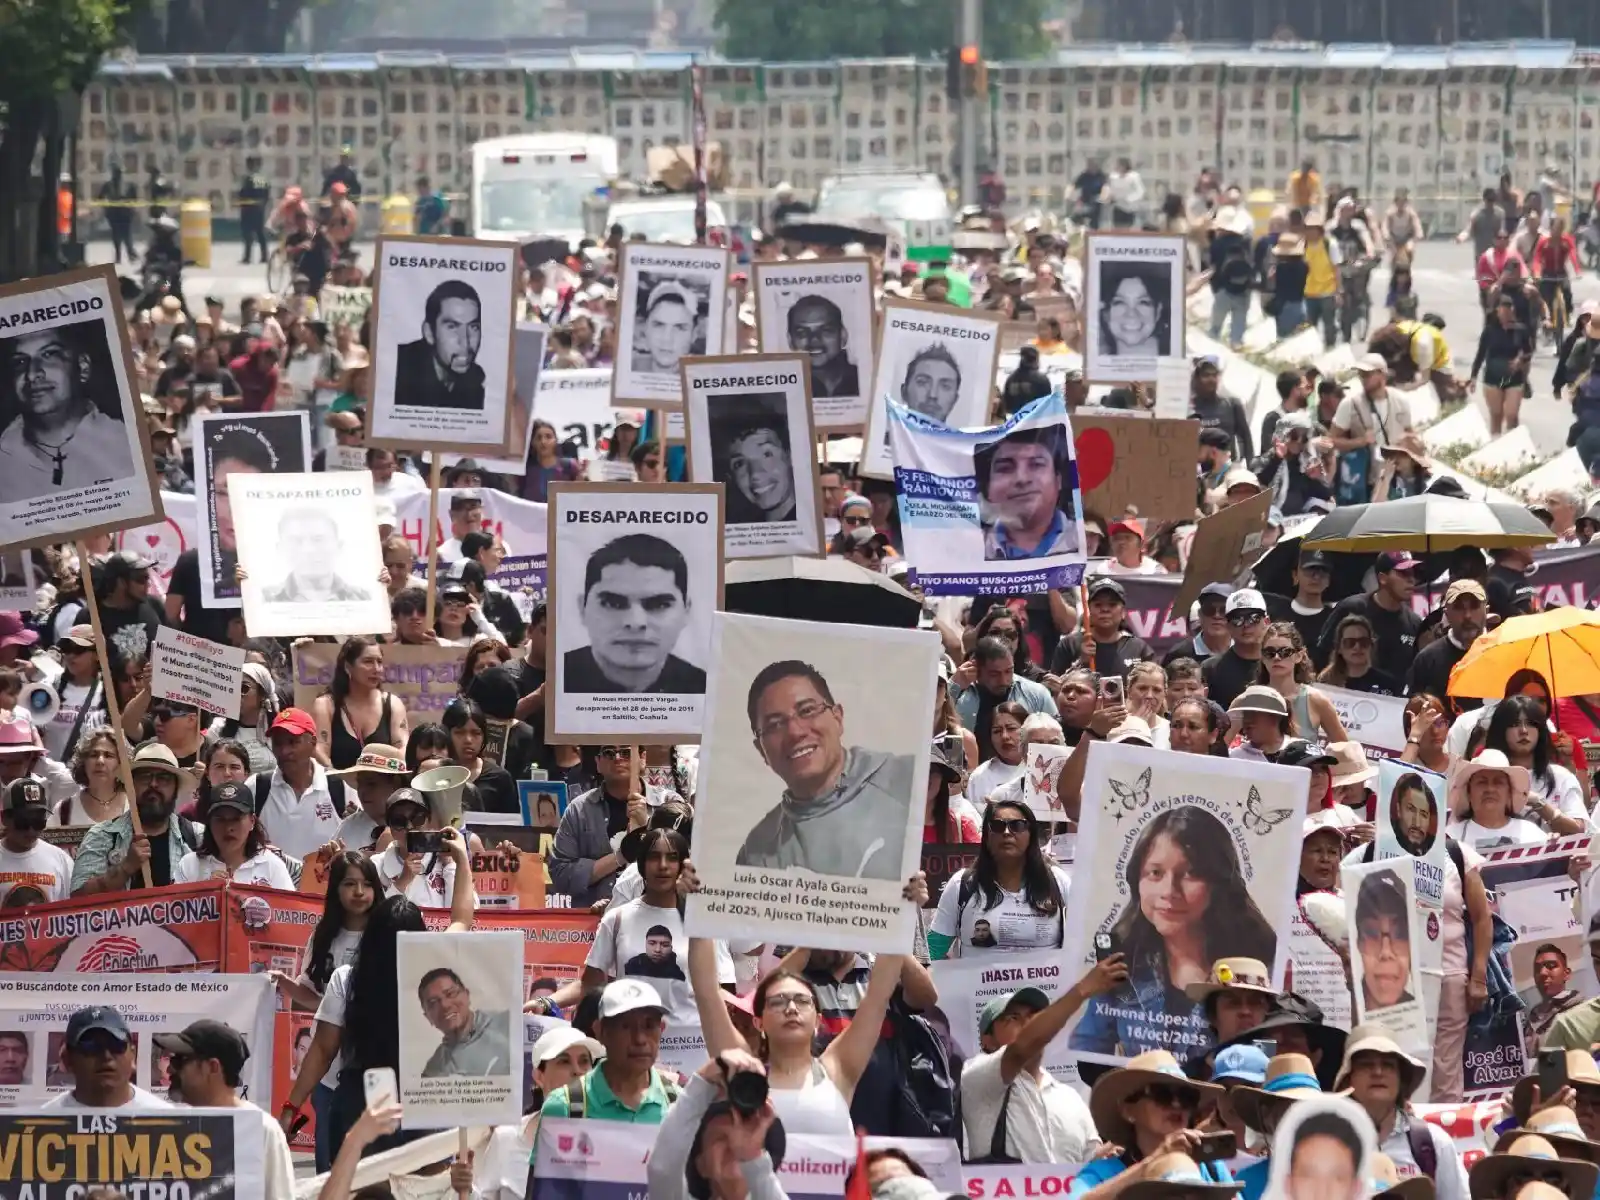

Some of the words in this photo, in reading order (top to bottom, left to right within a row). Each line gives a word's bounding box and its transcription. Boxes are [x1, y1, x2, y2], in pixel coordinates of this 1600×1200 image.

[389, 256, 507, 273] DESAPARECIDO
[630, 256, 722, 270] DESAPARECIDO
[765, 274, 863, 287] DESAPARECIDO
[0, 296, 104, 330] APARECIDO
[891, 319, 991, 341] DESAPARECIDO
[693, 374, 798, 389] DESAPARECIDO
[912, 472, 977, 489] FERNANDO
[566, 510, 709, 525] DESAPARECIDO
[918, 577, 941, 585] TIVO
[943, 577, 979, 585] MANOS
[981, 573, 1047, 585] BUSCADORAS
[978, 586, 991, 595] 33
[1035, 583, 1048, 592] 70
[575, 705, 621, 713] desaparecido
[650, 706, 667, 714] junio
[1137, 811, 1152, 826] no
[1152, 794, 1221, 813] dejaremos
[1219, 810, 1234, 826] de
[734, 873, 757, 885] Luis
[795, 878, 829, 893] Ayala
[545, 892, 573, 910] adre
[699, 884, 778, 902] desaparecido
[780, 892, 792, 905] el
[795, 893, 810, 906] 16
[811, 895, 827, 908] de
[706, 901, 726, 914] del
[728, 904, 761, 918] 2025,
[763, 906, 804, 923] Ajusco
[806, 911, 849, 927] Tlalpan
[851, 915, 888, 930] CDMX
[30, 918, 41, 939] Y
[981, 968, 1024, 984] ¡HASTA
[1027, 965, 1060, 980] ENCO
[16, 981, 79, 992] Buscándote
[81, 983, 100, 992] con
[103, 982, 133, 992] Amor
[135, 982, 172, 992] Estado
[174, 982, 188, 992] de
[191, 980, 229, 992] México
[1000, 986, 1018, 996] CHAV
[25, 1013, 56, 1022] JUNTOS
[1094, 1002, 1145, 1021] Ximena
[1149, 1010, 1190, 1028] López
[659, 1036, 704, 1045] RGENCIA
[1465, 1045, 1504, 1069] José
[77, 1114, 118, 1134] LAS
[0, 1125, 212, 1183] VÍCTIMAS
[994, 1177, 1017, 1198] A
[1024, 1175, 1076, 1197] LOC
